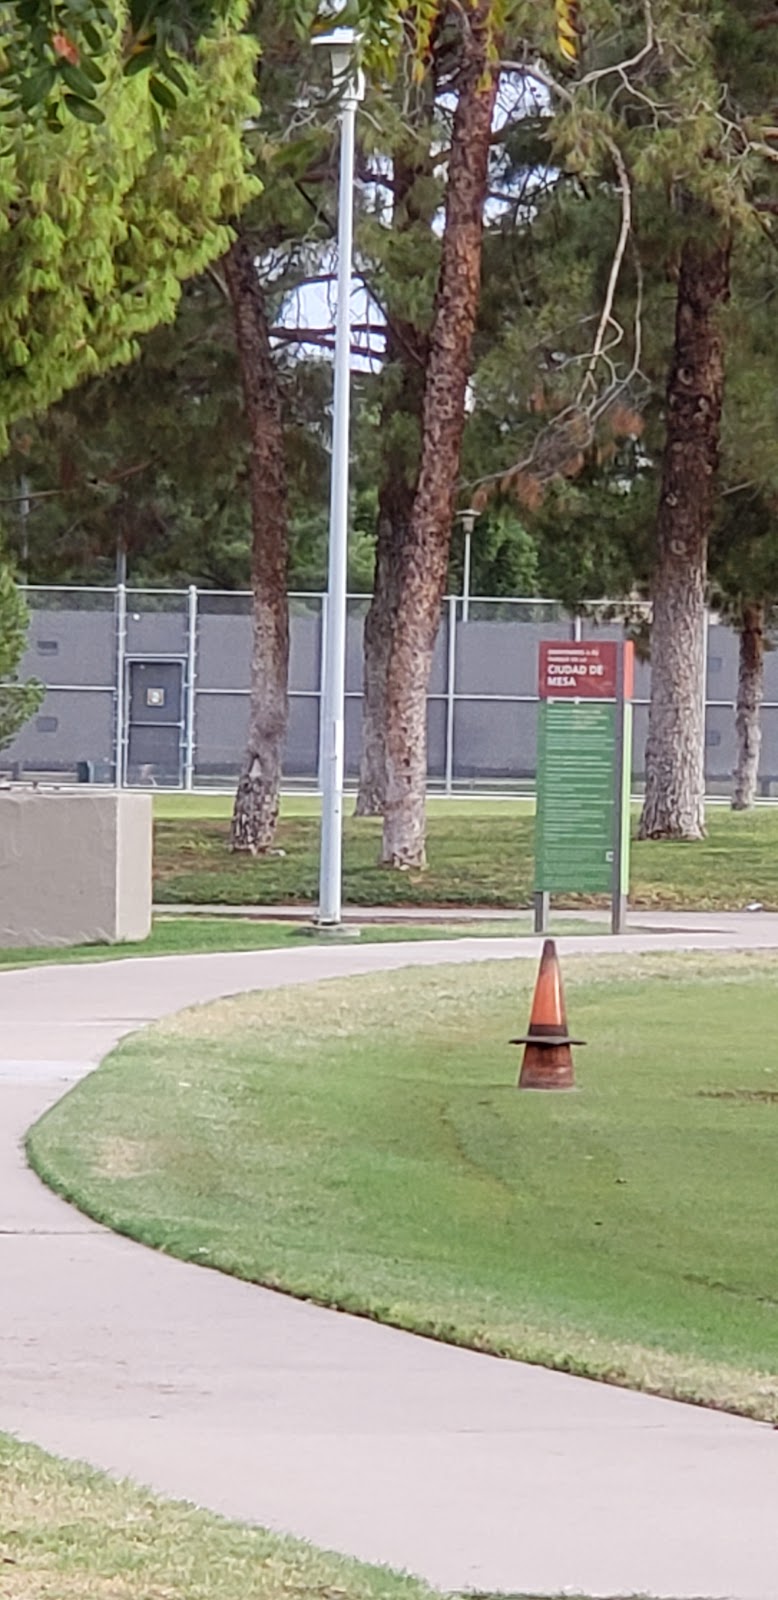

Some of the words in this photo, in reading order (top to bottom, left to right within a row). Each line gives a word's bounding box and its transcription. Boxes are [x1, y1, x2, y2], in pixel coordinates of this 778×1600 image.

[547, 664, 587, 675] CIUDAD
[588, 665, 604, 676] DE
[547, 676, 577, 687] MESA
